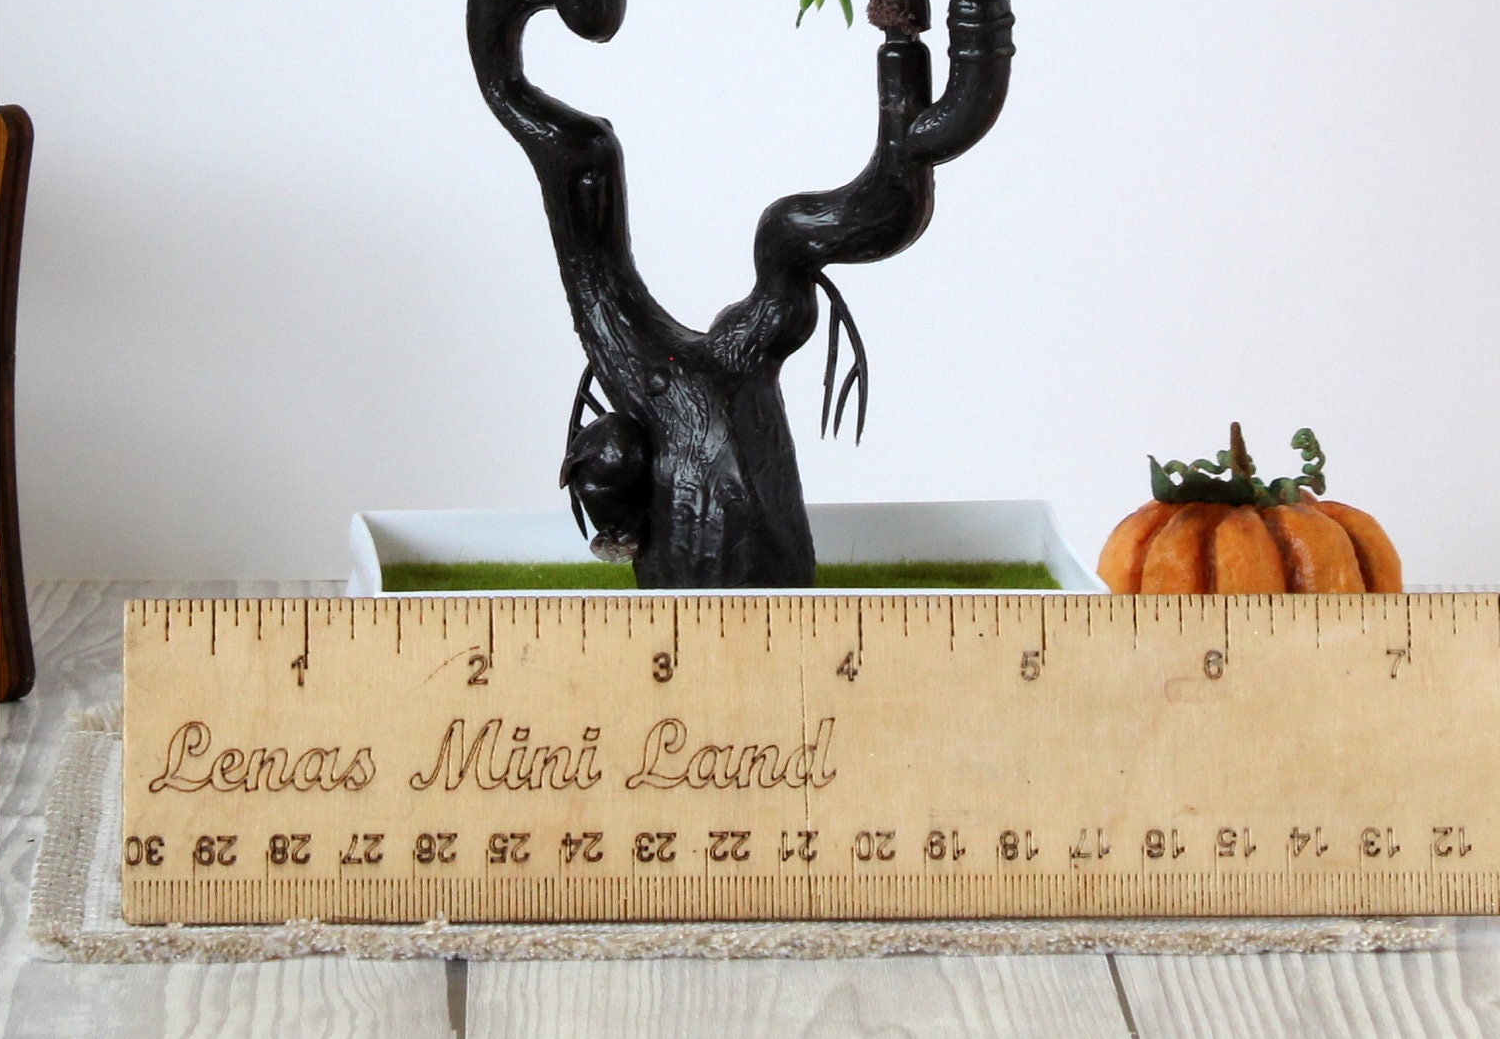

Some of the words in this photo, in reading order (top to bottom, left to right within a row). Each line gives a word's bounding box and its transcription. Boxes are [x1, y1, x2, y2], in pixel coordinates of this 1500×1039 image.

[291, 654, 307, 686] 1
[467, 654, 490, 686] 2
[652, 652, 674, 683] 3
[836, 651, 858, 682] 4
[1020, 651, 1041, 681] 5
[1203, 650, 1224, 680] 6
[1385, 649, 1406, 679] 7
[149, 720, 377, 794] Lenas
[409, 717, 602, 791] Mini
[625, 717, 837, 790] Land
[125, 835, 165, 866] 30
[196, 835, 238, 866] 29
[269, 834, 312, 865] 28
[342, 834, 384, 865] 27
[415, 833, 458, 864] 26
[489, 833, 531, 864] 25
[561, 832, 604, 863] 24
[635, 832, 677, 863] 23
[709, 831, 751, 862] 22
[780, 831, 818, 862] 21
[855, 831, 896, 862] 20
[925, 830, 966, 861] 19
[999, 830, 1039, 861] 18
[1070, 829, 1112, 860] 17
[1144, 829, 1186, 860] 16
[1216, 828, 1257, 859] 15
[1288, 828, 1328, 859] 14
[1361, 827, 1400, 858] 13
[1432, 827, 1472, 858] 12
